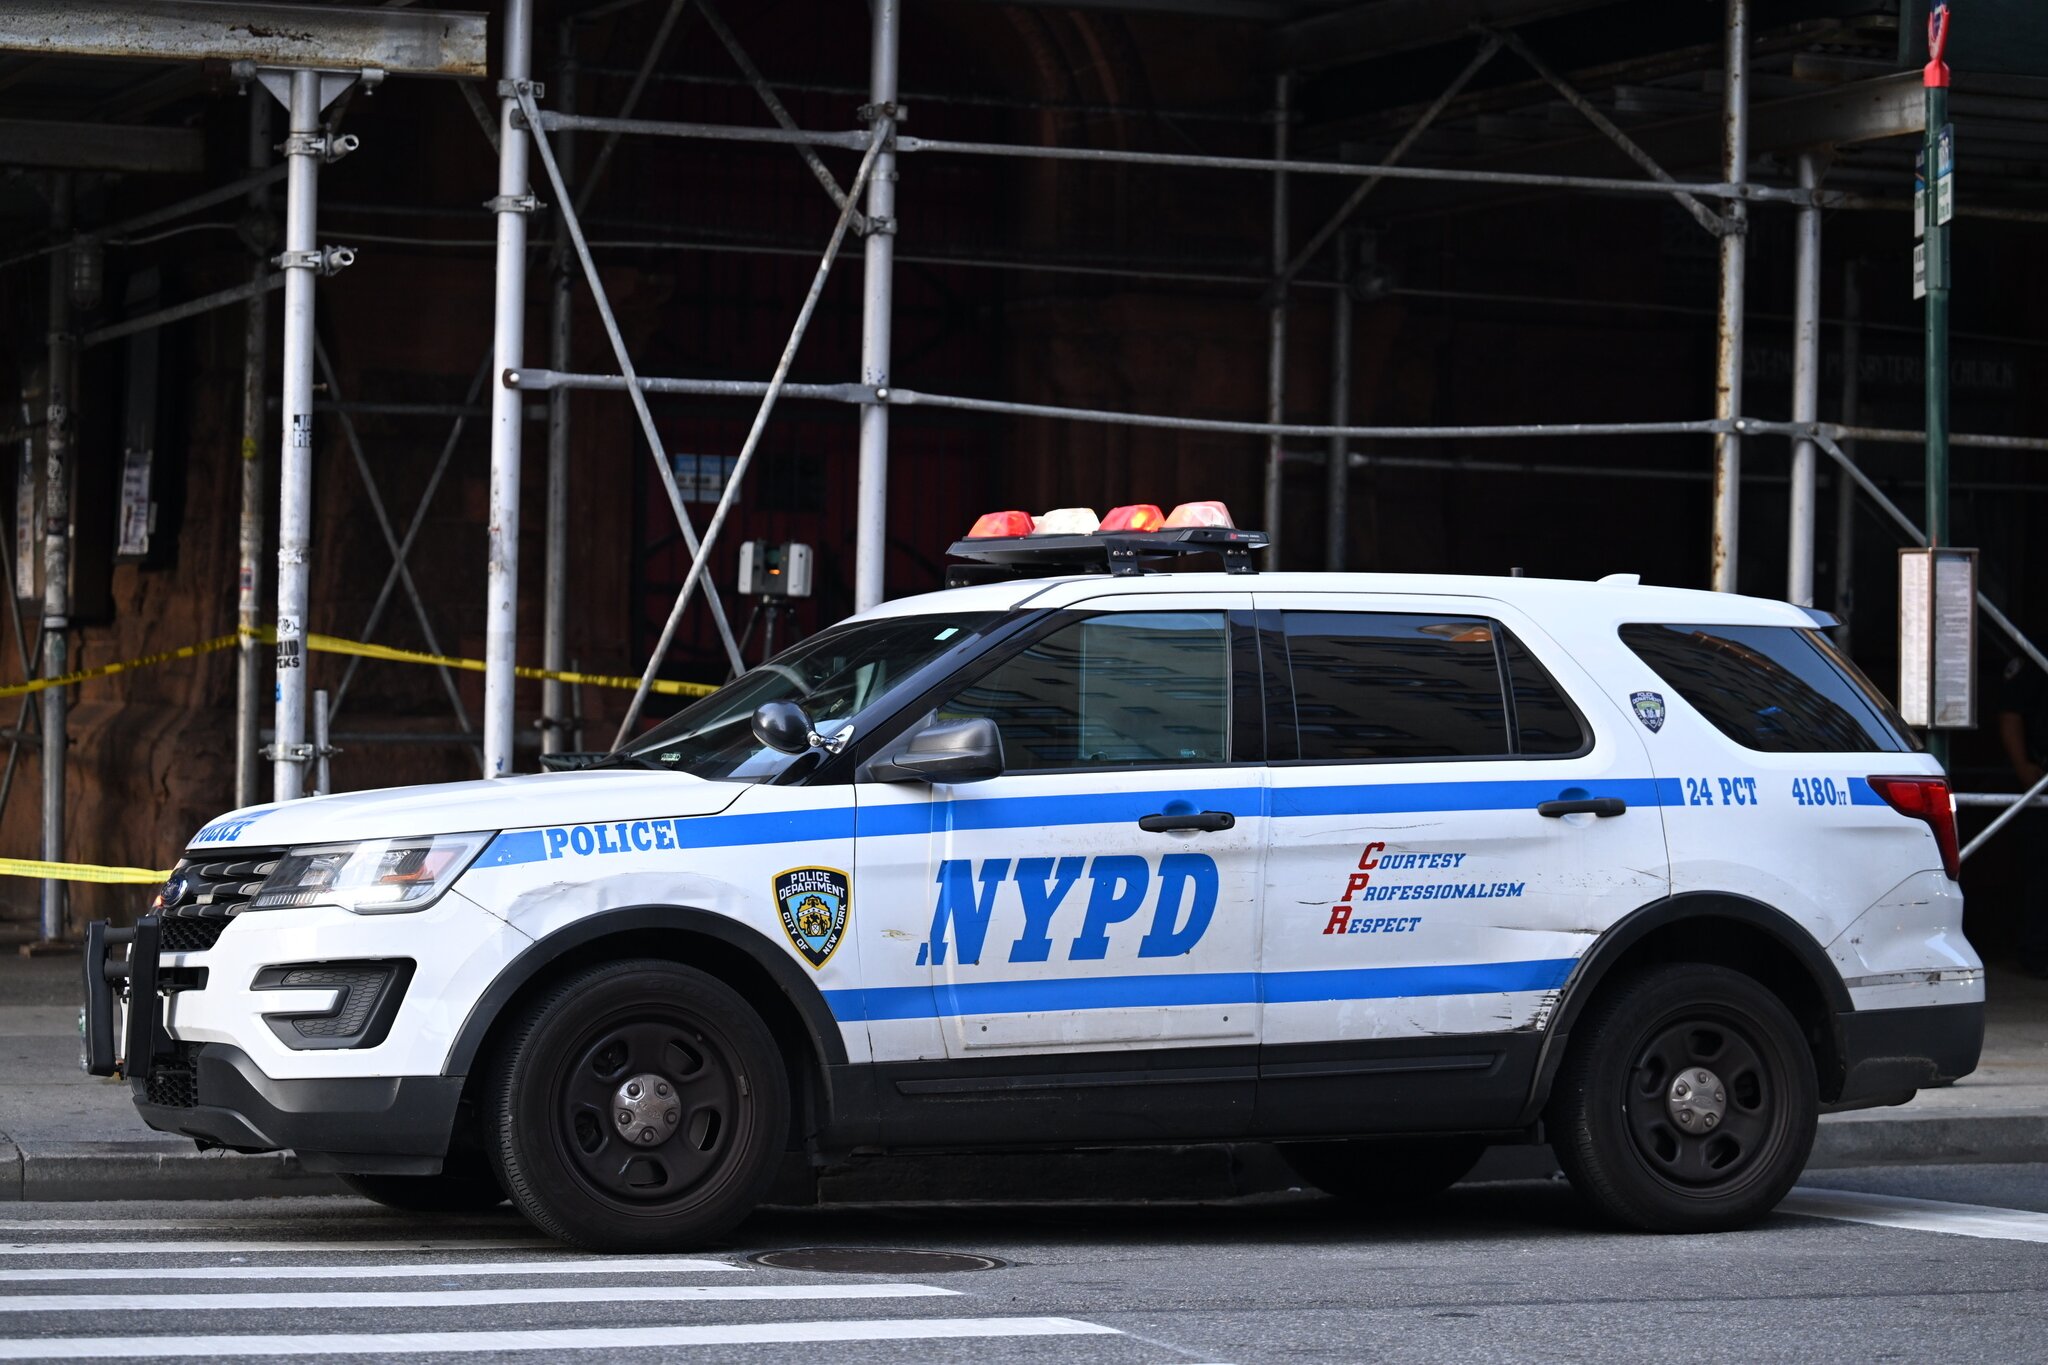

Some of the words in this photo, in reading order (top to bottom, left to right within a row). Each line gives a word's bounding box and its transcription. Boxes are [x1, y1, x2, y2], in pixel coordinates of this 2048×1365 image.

[1687, 777, 1714, 806] 24
[1718, 777, 1758, 806] PCT
[546, 820, 676, 859] POLICE
[779, 881, 845, 901] DEPARTMENT
[790, 871, 831, 884] POLICE
[915, 853, 1220, 966] NYPD
[782, 911, 798, 935] CITY
[796, 938, 809, 951] OF
[822, 933, 838, 955] NEW
[834, 904, 847, 930] YORK
